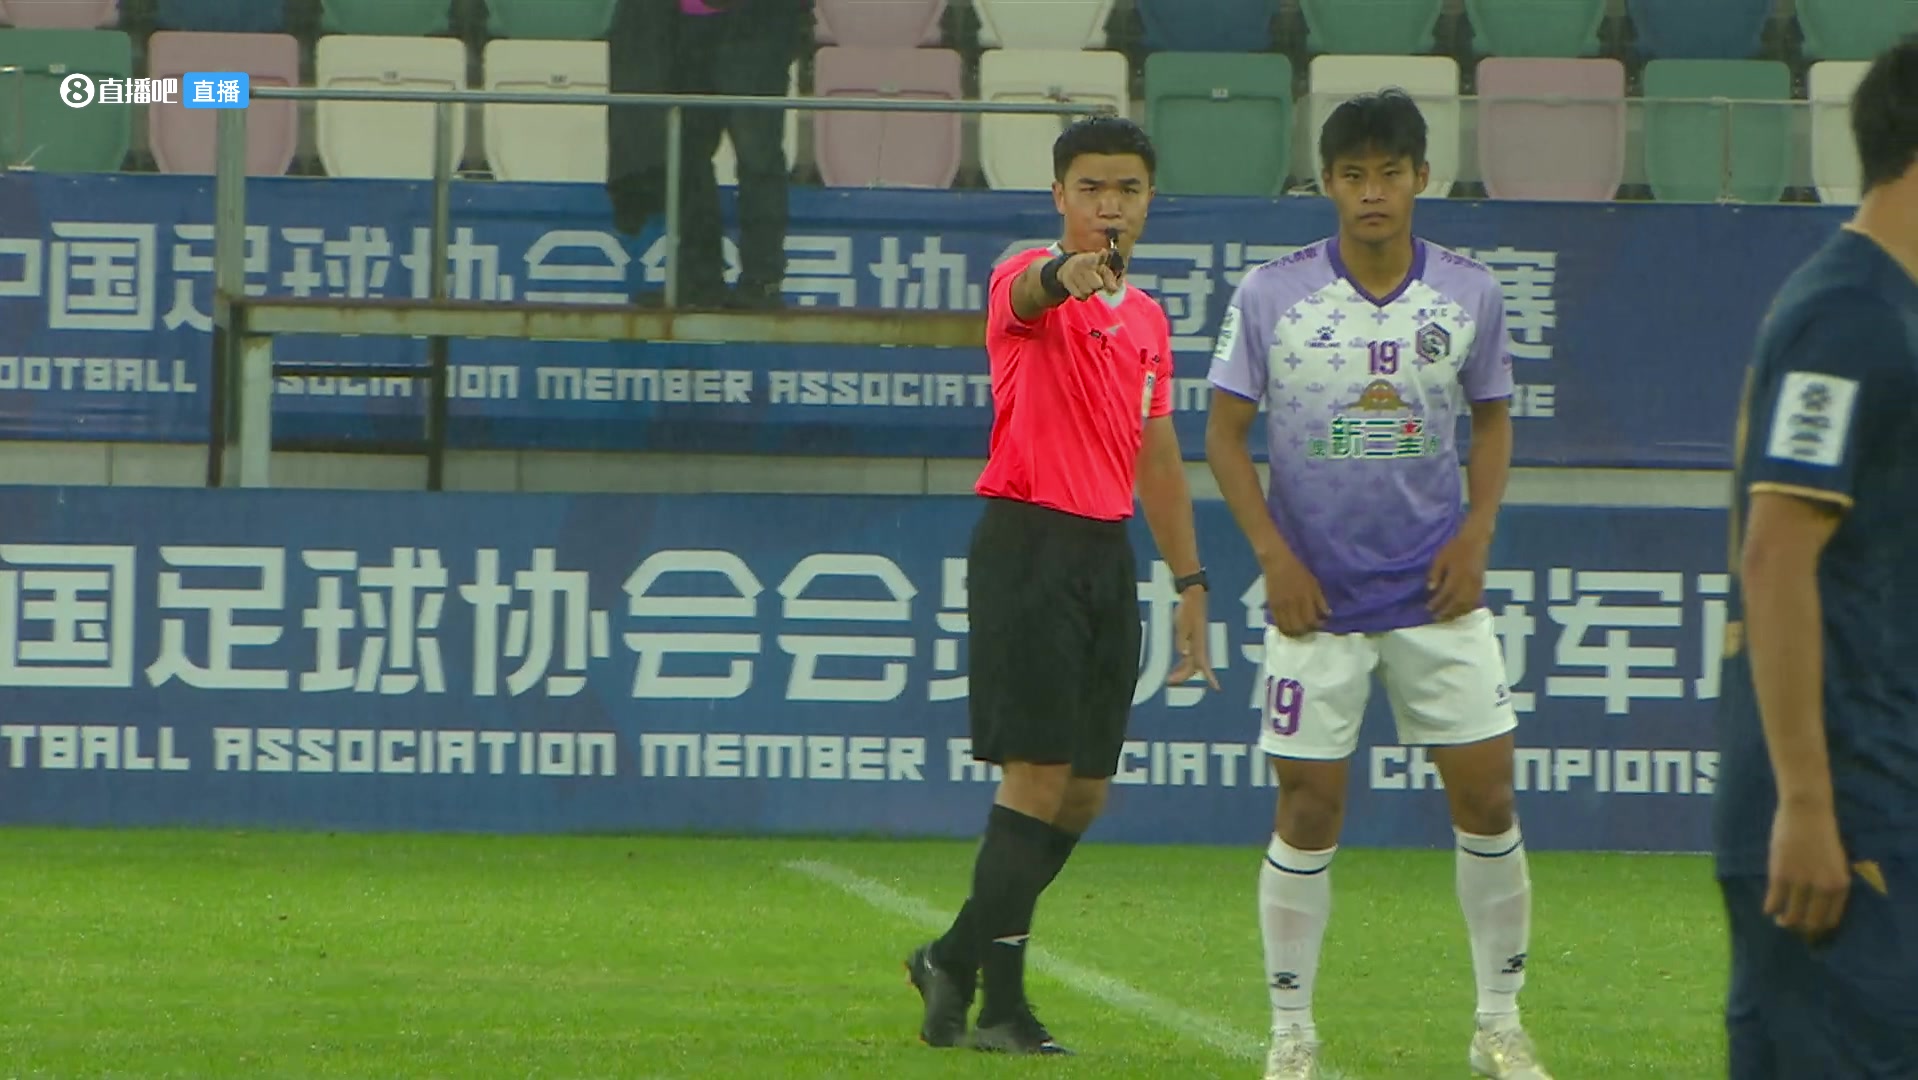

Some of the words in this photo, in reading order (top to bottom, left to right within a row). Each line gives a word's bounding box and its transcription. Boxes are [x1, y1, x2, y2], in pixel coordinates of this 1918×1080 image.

[1367, 340, 1399, 375] 19
[536, 366, 754, 404] MEMBER
[1264, 676, 1304, 736] 19
[212, 727, 617, 776] ASSOCIATION
[641, 733, 926, 782] MEMBER
